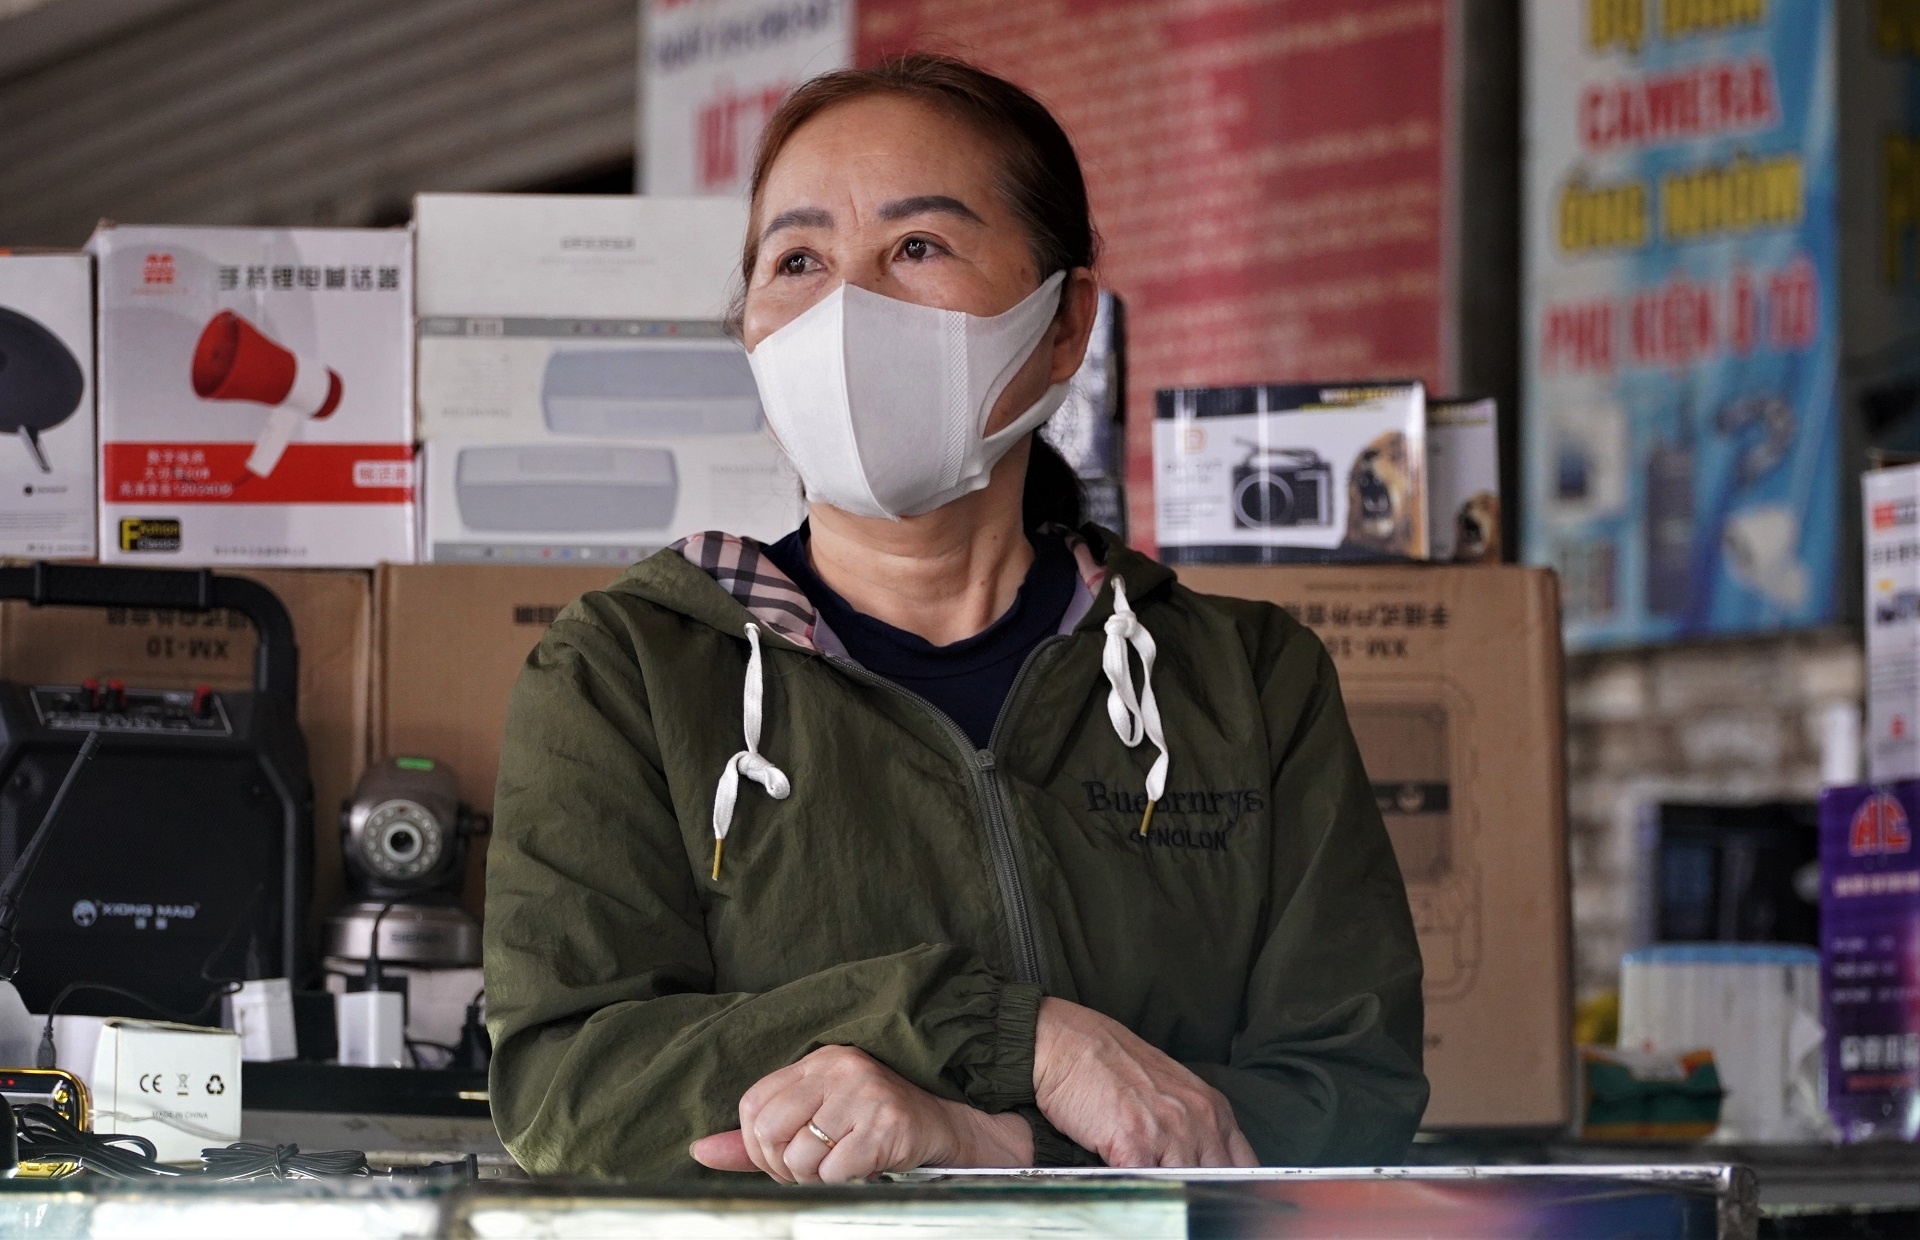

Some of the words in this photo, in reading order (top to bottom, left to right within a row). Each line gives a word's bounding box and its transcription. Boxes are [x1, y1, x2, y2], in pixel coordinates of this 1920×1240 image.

[1580, 58, 1778, 148] CAMERA
[139, 1073, 162, 1094] CE
[152, 1111, 173, 1120] MADE
[174, 1111, 183, 1119] IN
[184, 1111, 208, 1120] CHINA
